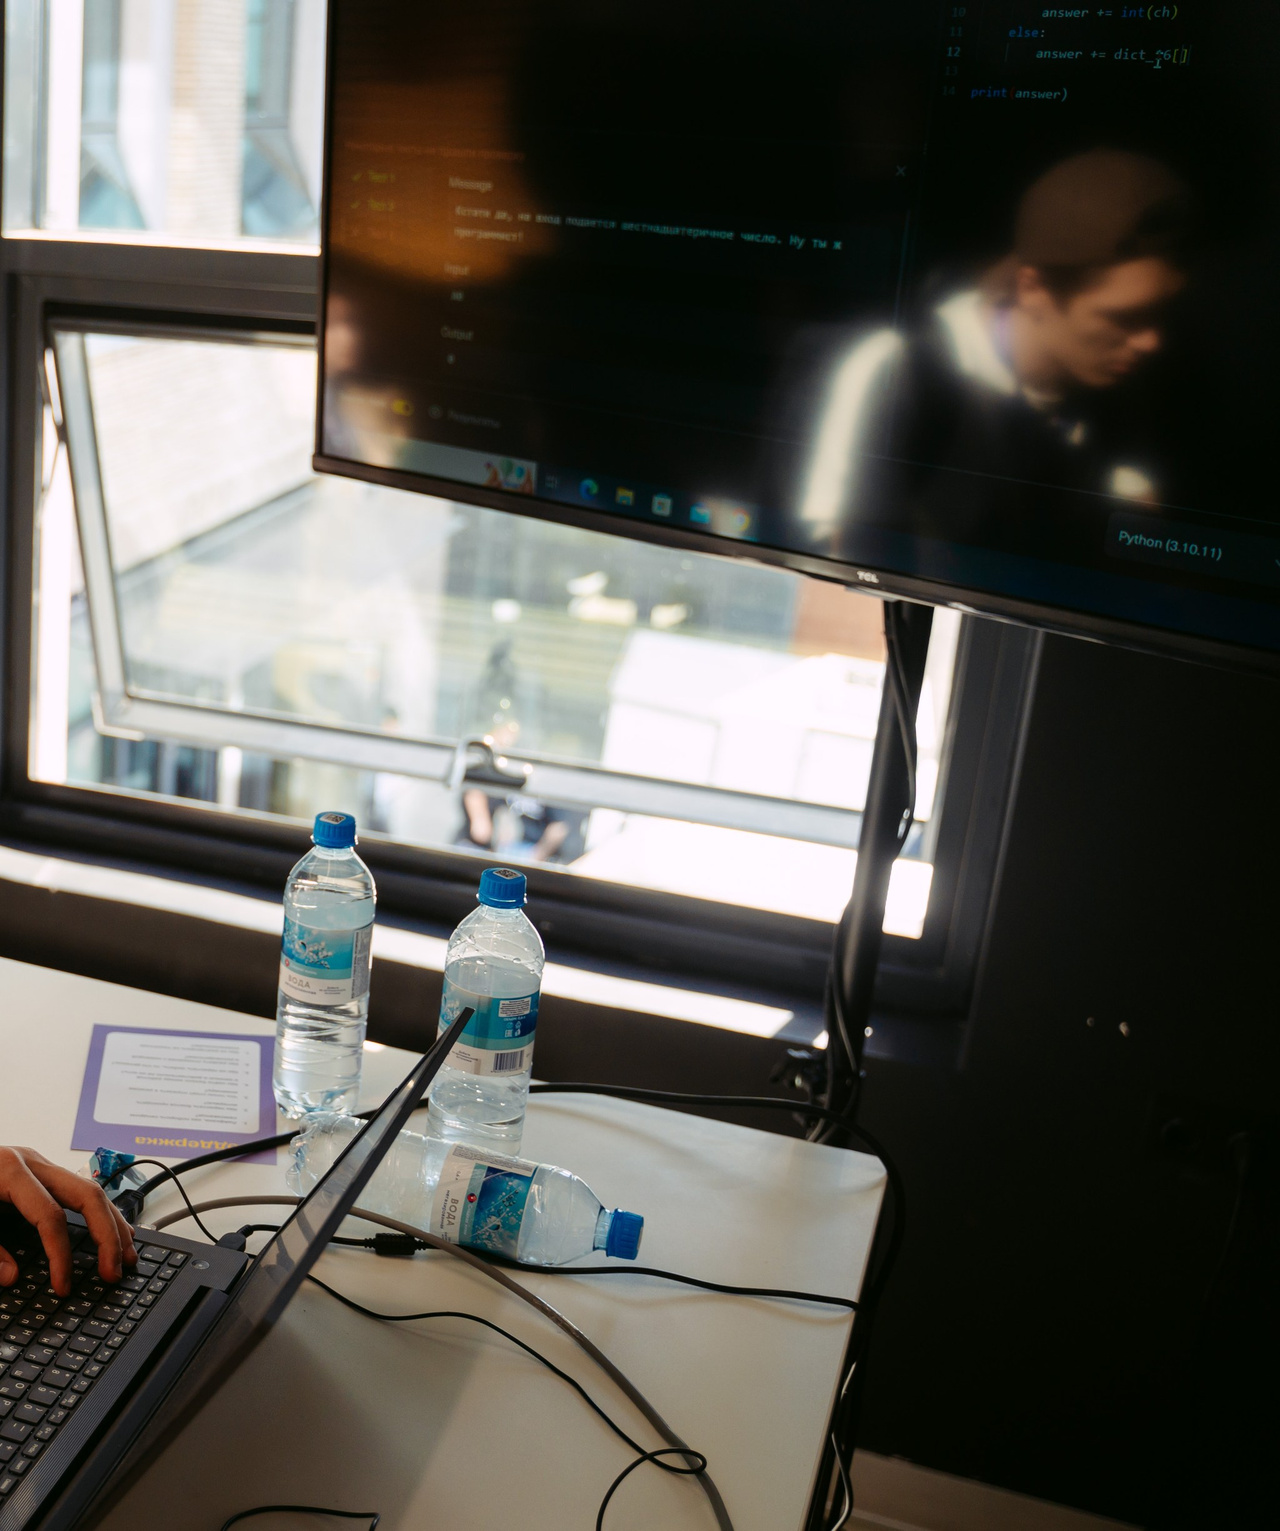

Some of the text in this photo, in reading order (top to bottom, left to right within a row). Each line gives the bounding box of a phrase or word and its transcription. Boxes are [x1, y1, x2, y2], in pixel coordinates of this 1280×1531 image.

[1042, 8, 1089, 18] answer
[1097, 9, 1113, 17] +=
[1121, 5, 1179, 20] int(ch)
[1008, 26, 1045, 38] else:
[946, 46, 961, 58] 12
[1035, 49, 1083, 60] answer
[1090, 50, 1106, 59] +=
[970, 86, 1068, 102] print(answer)
[740, 231, 782, 245] число.
[789, 234, 806, 250] Ну
[812, 238, 828, 250] ты
[1118, 530, 1222, 561] Python (3.10.11)
[856, 571, 879, 584] TCL
[288, 974, 311, 989] ВОДА
[135, 1136, 240, 1150] оддержка
[446, 1198, 459, 1226] ВОДА
